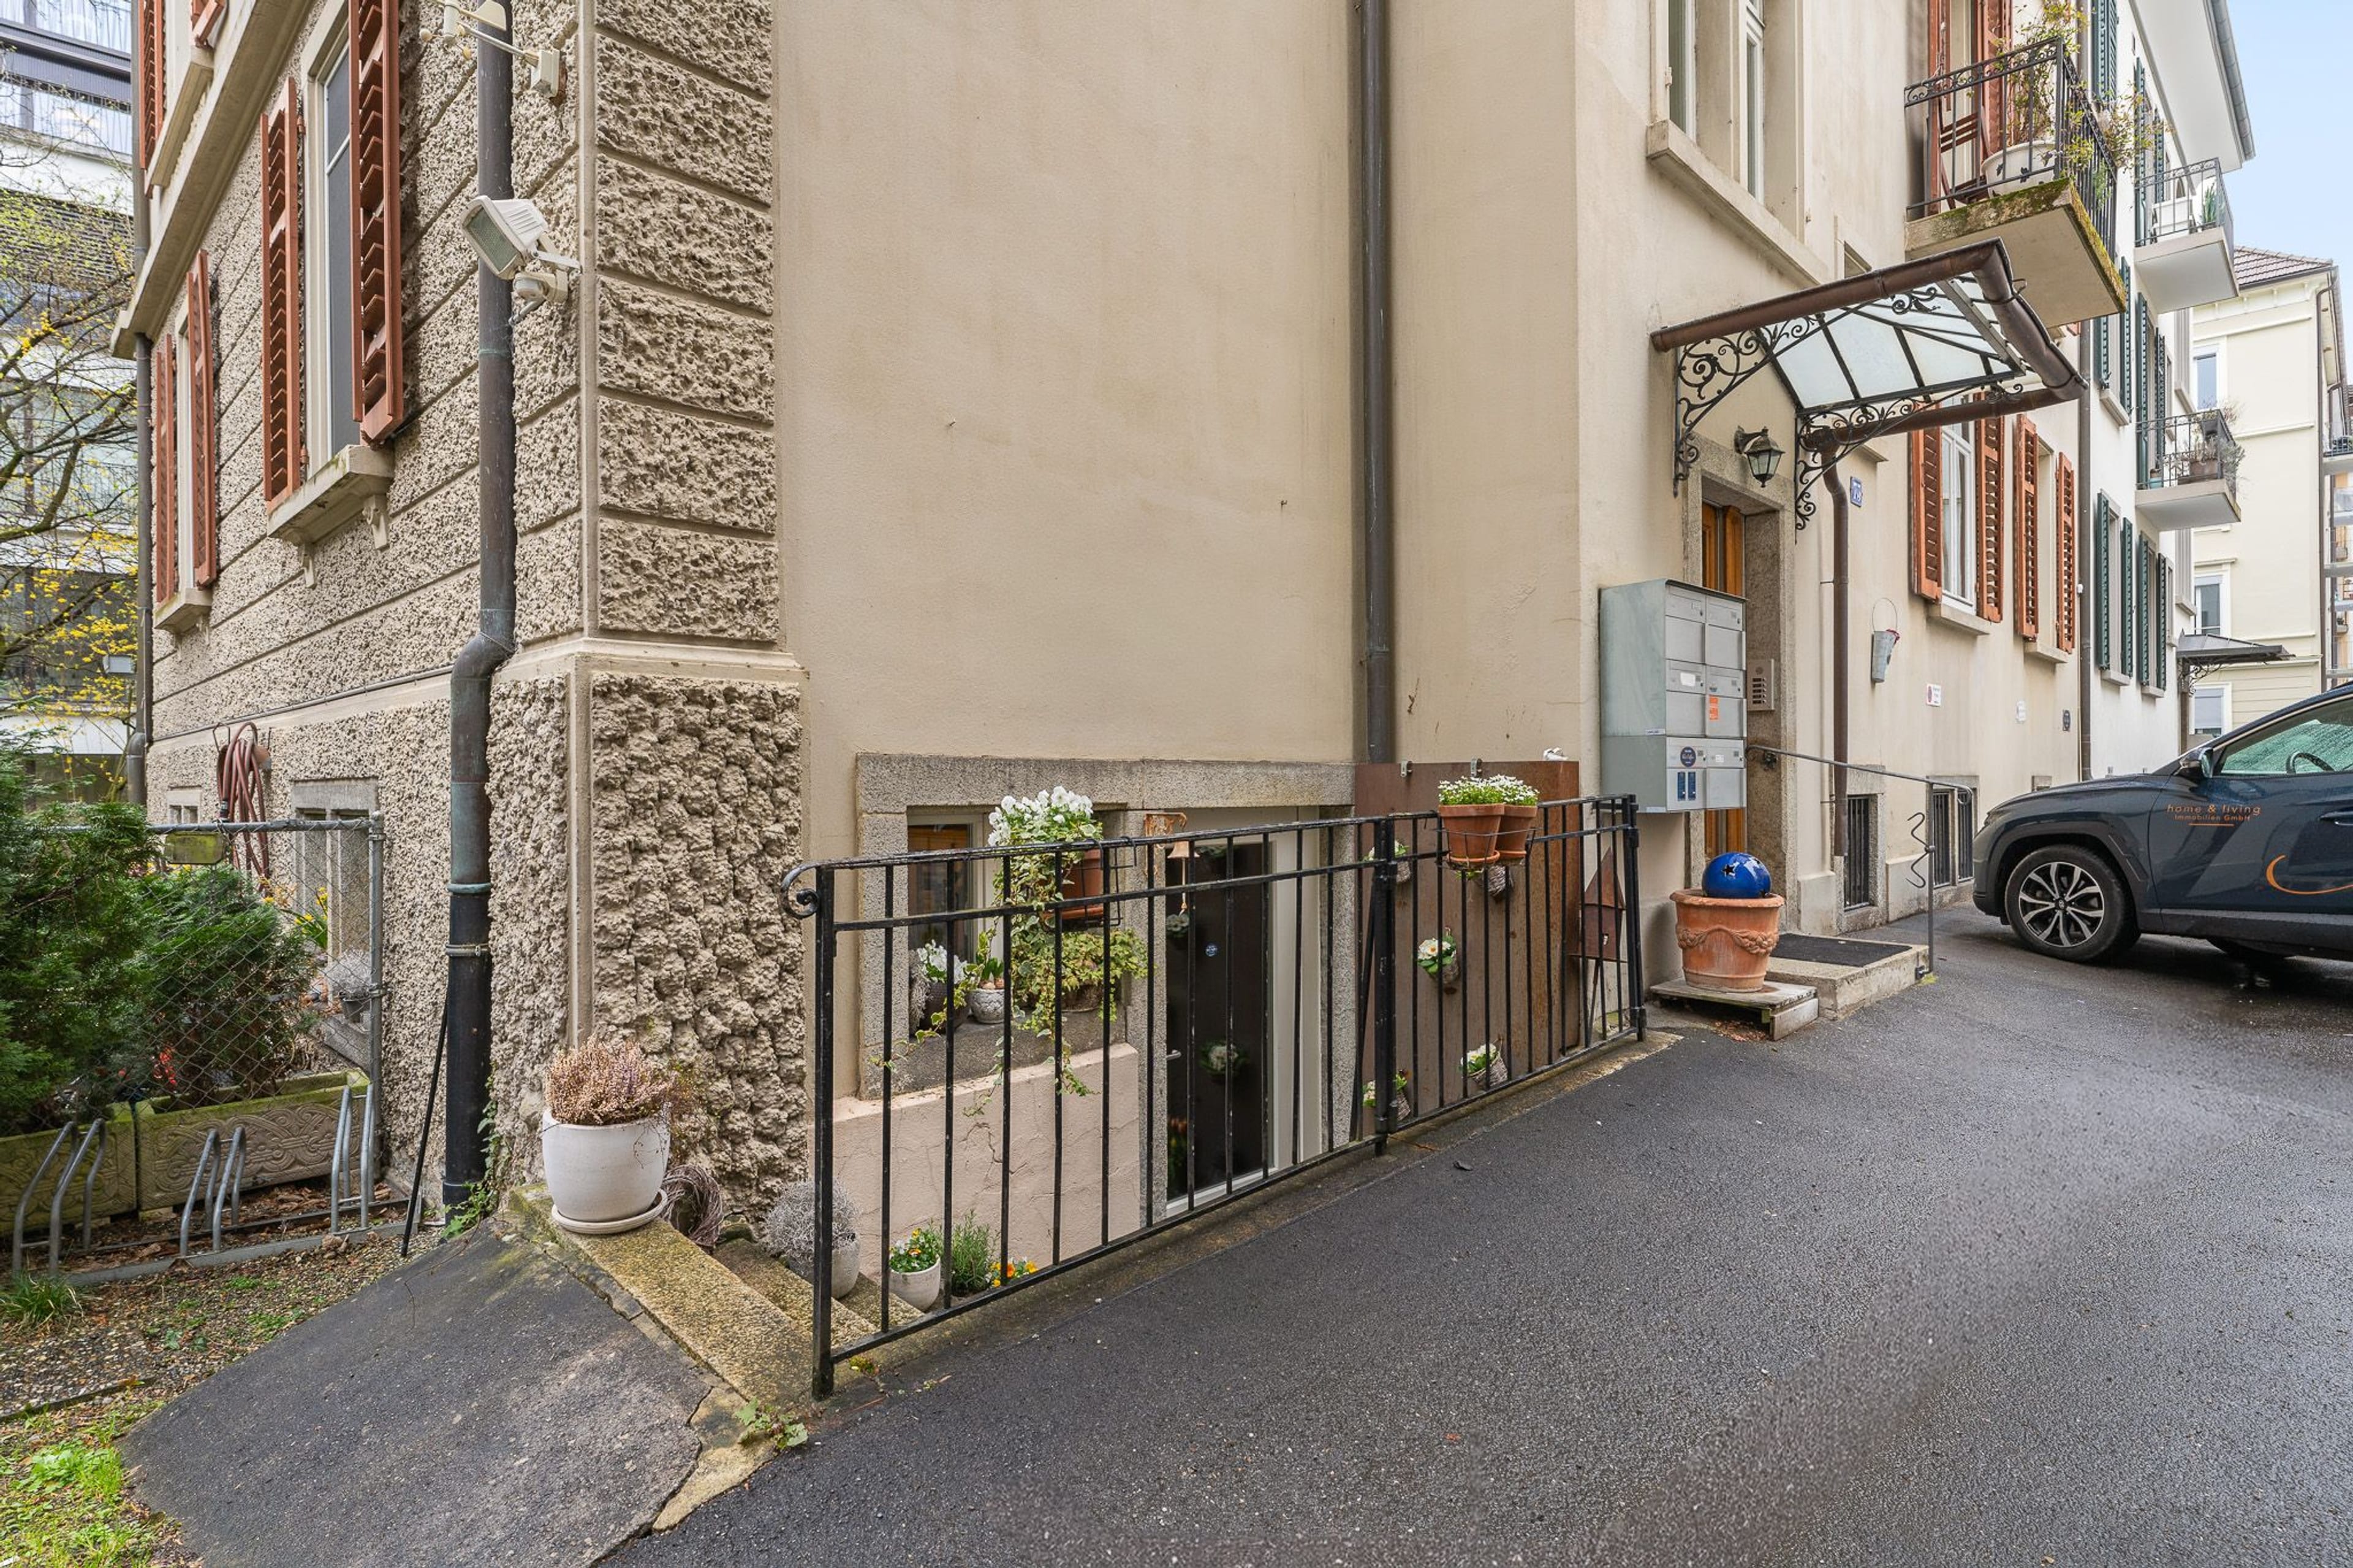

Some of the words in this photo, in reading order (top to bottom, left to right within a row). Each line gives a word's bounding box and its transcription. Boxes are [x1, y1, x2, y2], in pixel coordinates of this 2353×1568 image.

[2167, 803, 2202, 813] home
[2208, 803, 2216, 813] &
[2222, 803, 2261, 816] living
